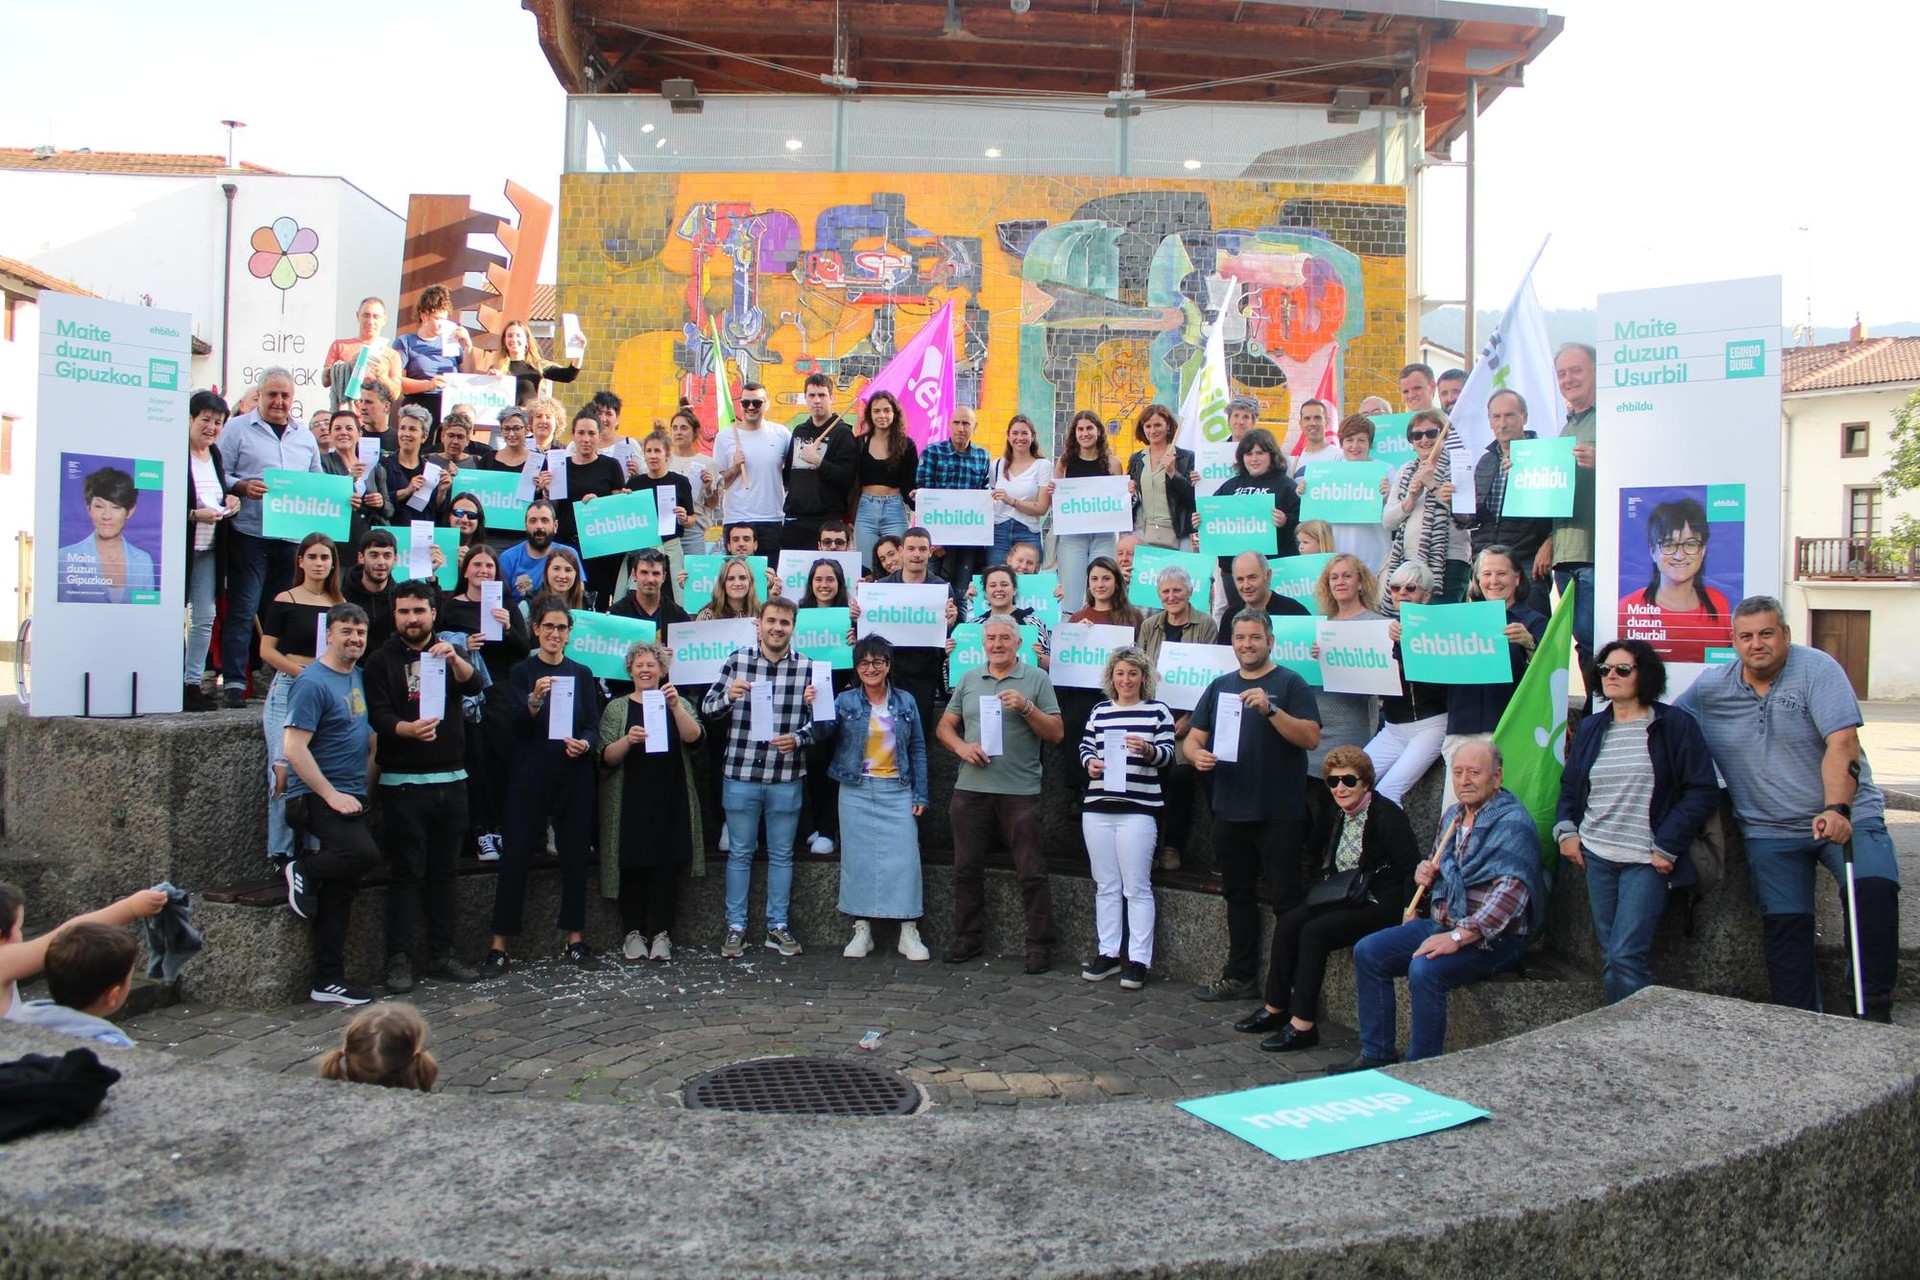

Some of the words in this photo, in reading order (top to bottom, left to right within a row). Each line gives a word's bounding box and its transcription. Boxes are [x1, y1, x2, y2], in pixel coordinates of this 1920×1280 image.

[57, 319, 111, 342] Maite
[149, 326, 180, 337] ehbildu
[1614, 318, 1677, 339] Maite
[262, 330, 305, 353] aire
[56, 341, 112, 362] duzun
[1614, 344, 1679, 363] duzun
[1729, 345, 1760, 358] EGINGO
[55, 361, 141, 386] Gipuzkoa
[1614, 362, 1688, 387] Usurbil
[1616, 400, 1653, 412] ehbildu
[1514, 465, 1567, 489] ehbildu
[1310, 482, 1374, 500] ehbildu
[271, 493, 340, 518] ehbildu
[1061, 496, 1123, 514] ehbildu
[585, 511, 648, 537] ehbildu
[923, 508, 984, 525] ehbildu
[1206, 516, 1267, 535] ehbildu
[68, 553, 97, 562] Maite
[67, 564, 97, 573] duzun
[66, 575, 113, 585] Gipuzkoa
[866, 605, 937, 624] ehbildu
[1627, 603, 1661, 615] Maite
[1627, 616, 1662, 627] duzun
[1410, 631, 1495, 655] ehbildu
[1627, 629, 1666, 640] Usurbil
[573, 633, 632, 657] ehbild
[1325, 646, 1388, 668] ehbildu
[1241, 1091, 1412, 1129] ehbildu
